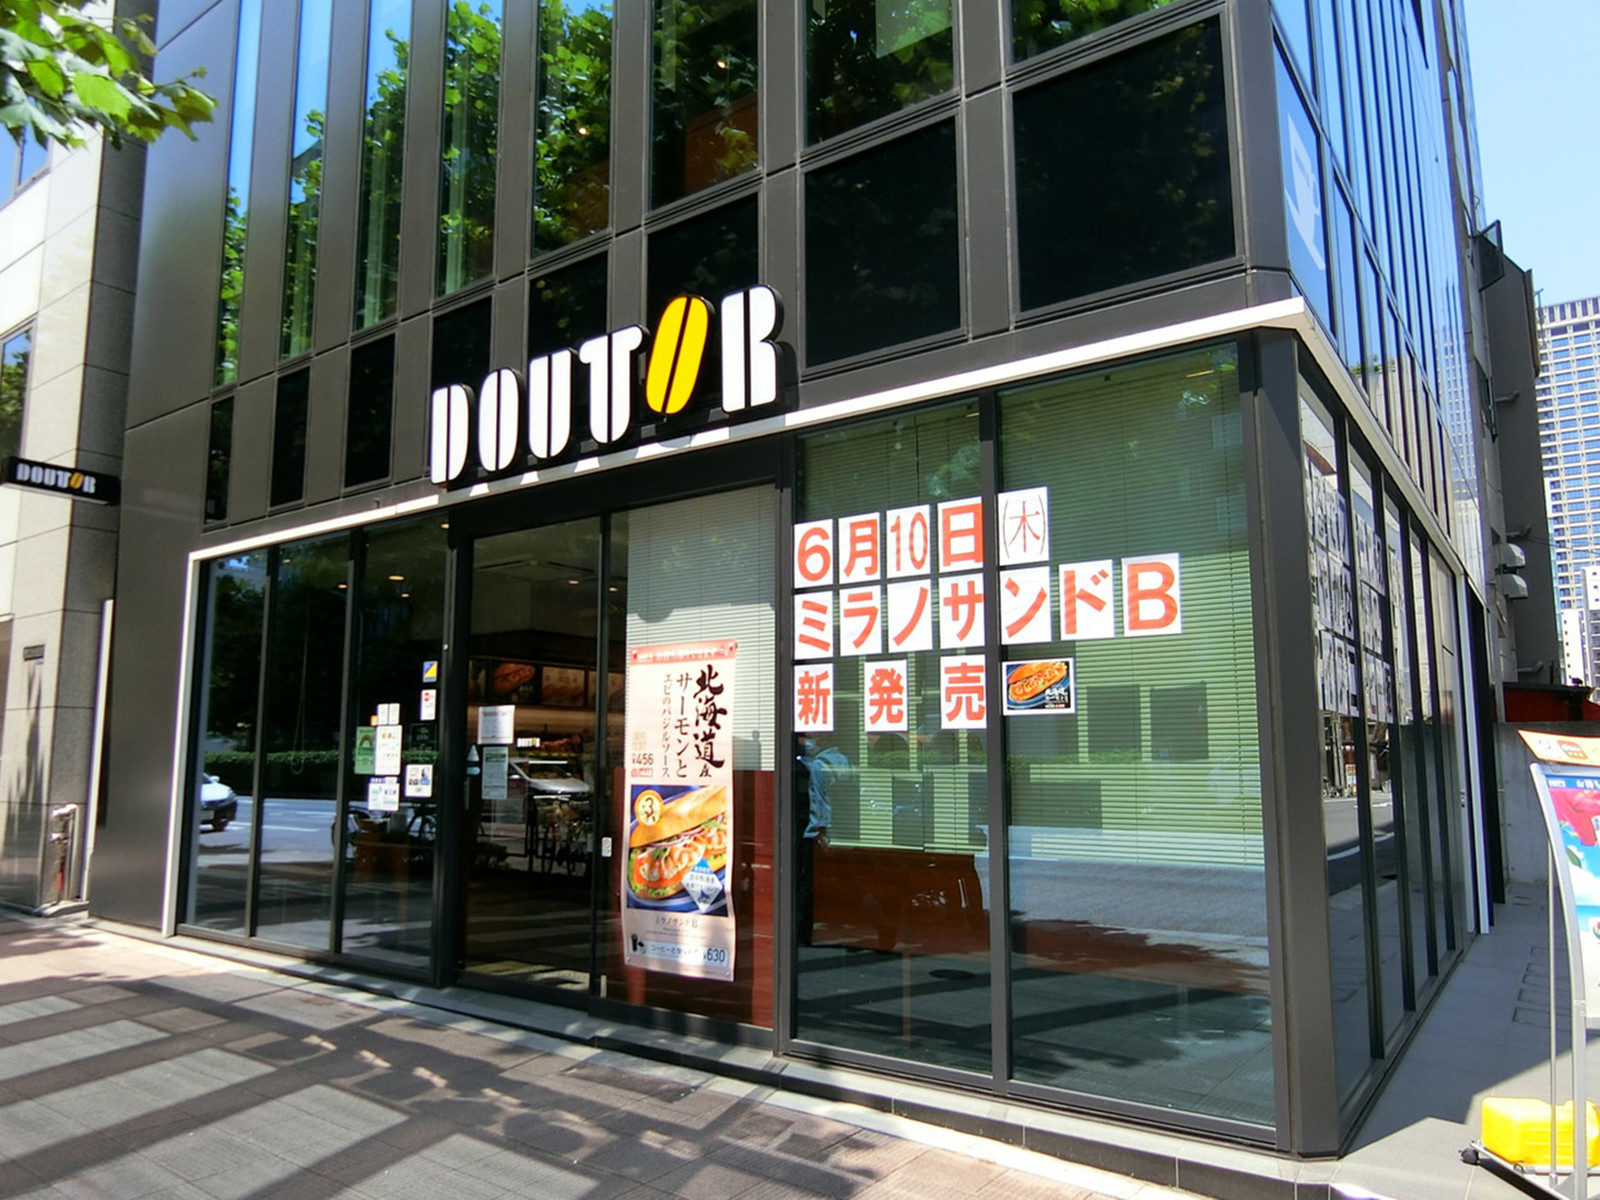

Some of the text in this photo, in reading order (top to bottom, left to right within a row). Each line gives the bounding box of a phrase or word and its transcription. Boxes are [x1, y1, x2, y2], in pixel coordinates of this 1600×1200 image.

[430, 284, 778, 485] DOUTOR
[15, 462, 97, 494] DOUTOR
[797, 561, 1179, 652] ミラノサンドB
[674, 672, 692, 778] サーモンと
[797, 661, 987, 726] 新発売
